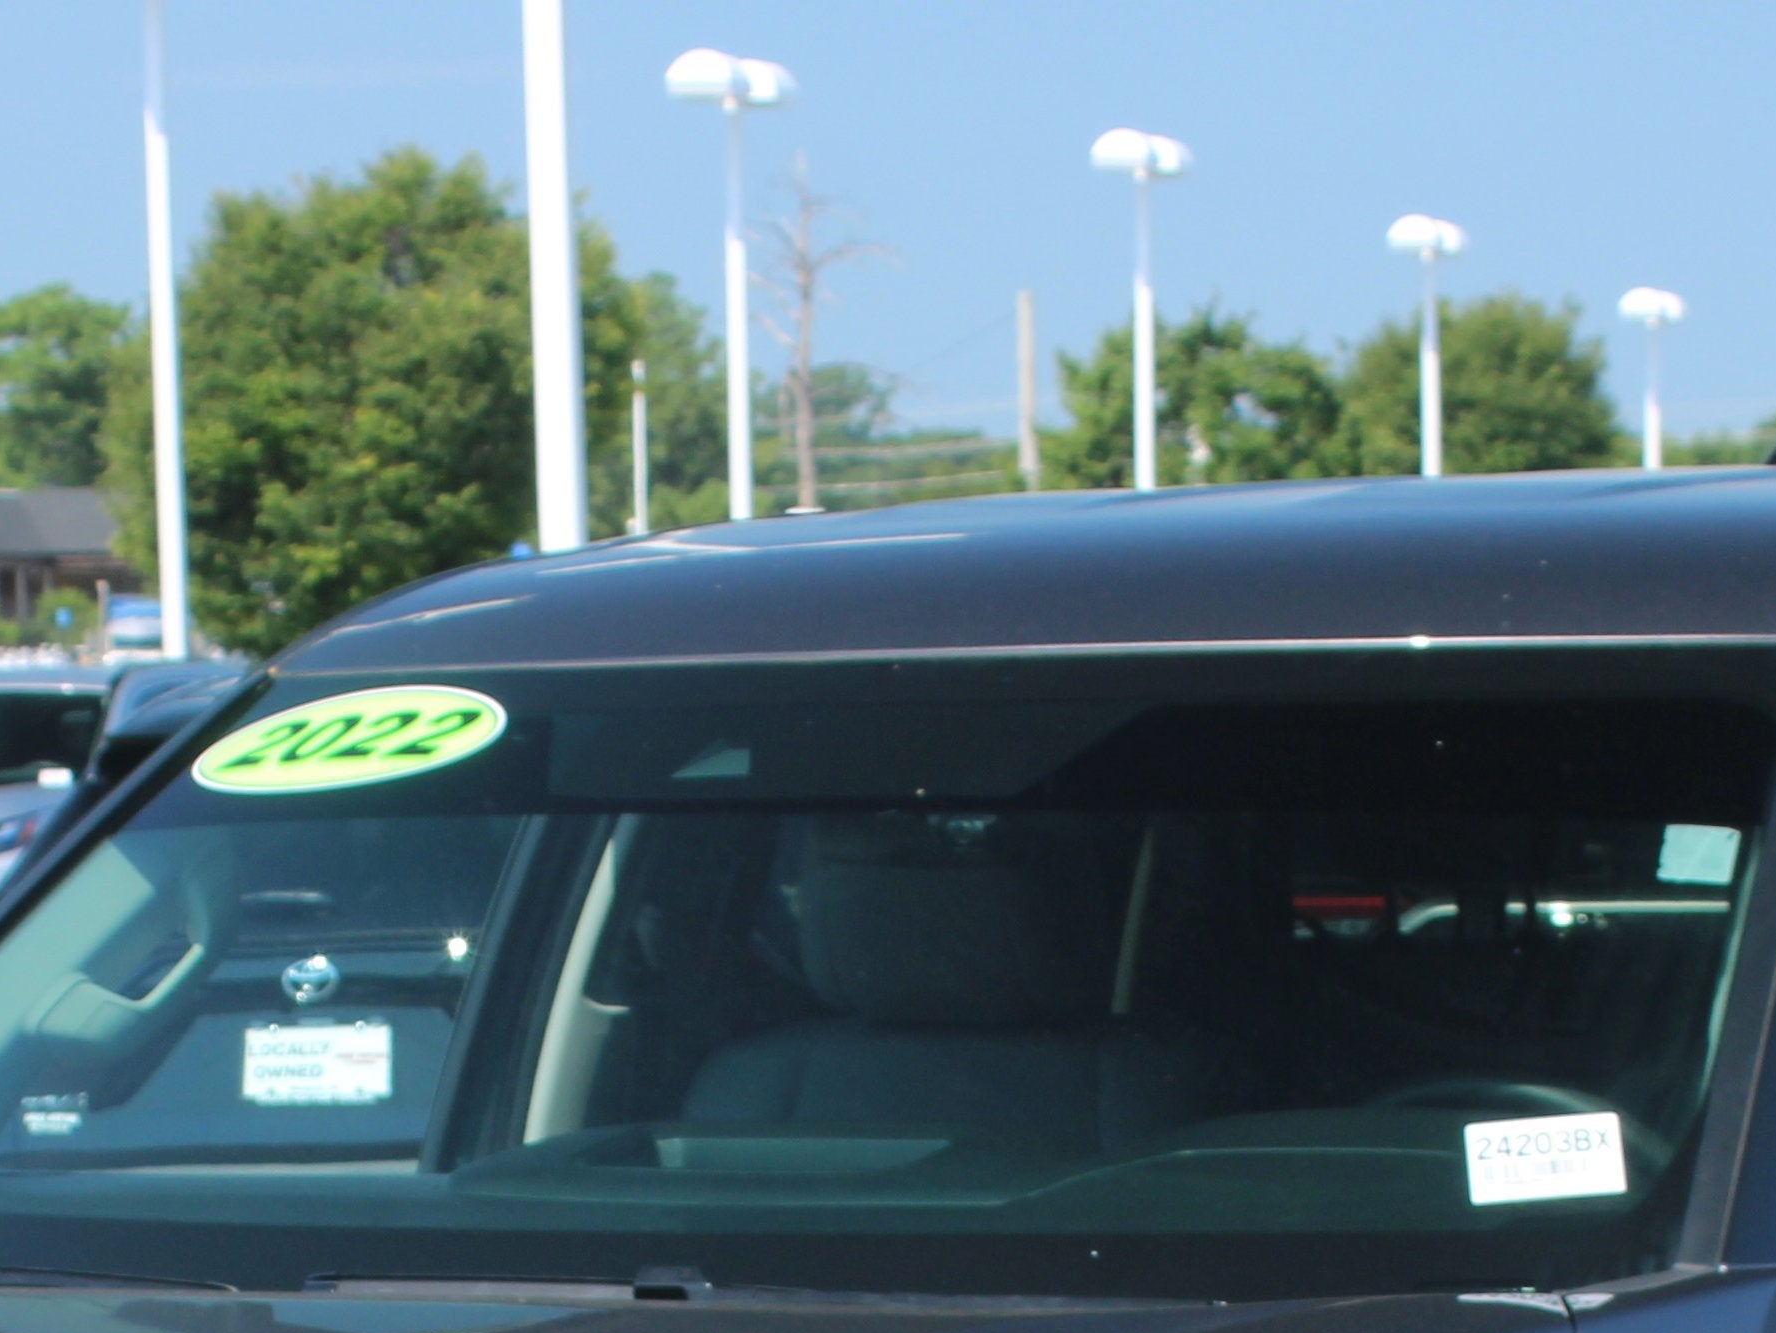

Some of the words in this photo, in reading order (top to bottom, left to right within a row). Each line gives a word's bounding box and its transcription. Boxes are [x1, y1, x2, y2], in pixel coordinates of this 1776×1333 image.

[216, 708, 484, 771] 2022
[247, 1040, 332, 1056] LOCALLY
[254, 1063, 323, 1079] OWNED
